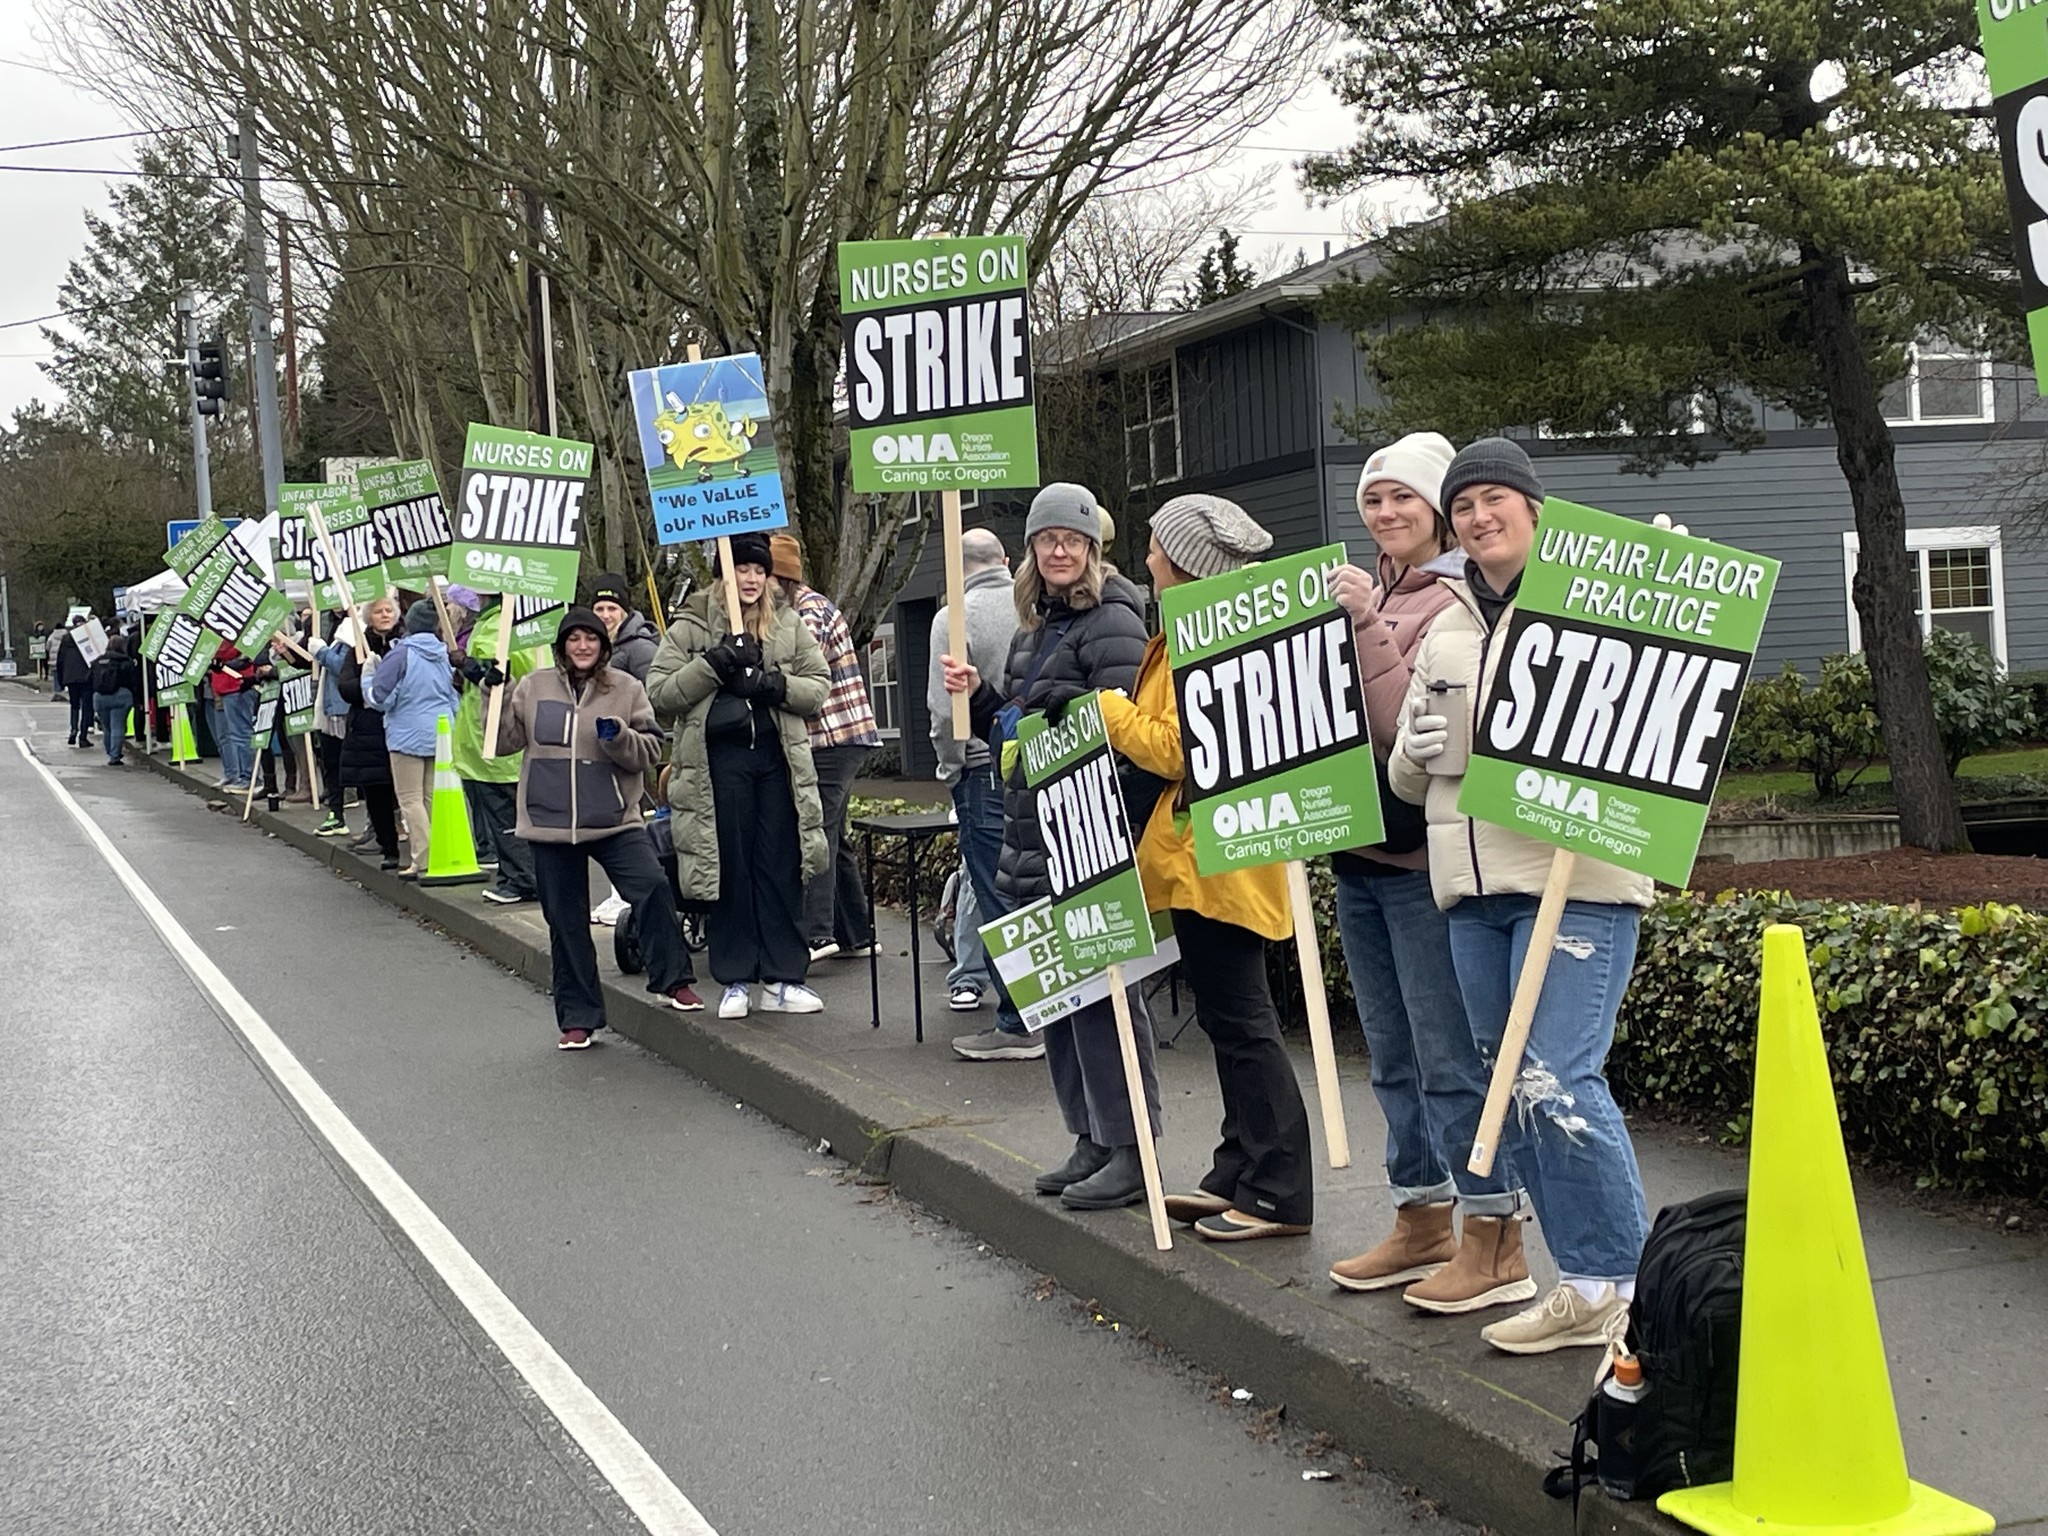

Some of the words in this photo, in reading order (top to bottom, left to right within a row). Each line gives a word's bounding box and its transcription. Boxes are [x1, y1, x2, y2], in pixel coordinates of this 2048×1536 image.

[852, 252, 968, 303] NURSES
[977, 245, 1018, 284] ON
[854, 297, 1025, 421] STRIKE
[471, 440, 553, 469] NURSES
[559, 447, 589, 472] ON
[872, 433, 959, 465] ONA
[961, 433, 993, 443] Oregon
[361, 471, 397, 492] UNFAIR
[397, 463, 430, 483] LABOR
[378, 482, 425, 503] PRACTICE
[881, 467, 928, 485] Caring
[932, 467, 951, 481] for
[954, 466, 1007, 483] Oregon
[282, 490, 314, 503] UNFAIR
[316, 485, 349, 500] LABOR
[460, 472, 585, 546] STRIKE
[170, 541, 197, 567] UNFAIR
[195, 517, 219, 542] LABOR
[373, 496, 451, 557] STRIKE
[663, 517, 696, 534] oUr
[184, 532, 221, 567] PRACTICE
[465, 549, 524, 577] ONA
[1539, 527, 1650, 579] UNFAIR
[1653, 548, 1765, 600] LABOR
[188, 571, 221, 616] NURSES
[214, 553, 232, 573] ON
[468, 571, 501, 588] Caring
[518, 579, 554, 594] Oregon
[204, 564, 268, 641] STRIKE
[1175, 577, 1290, 656] NURSES
[1563, 577, 1722, 636] PRACTICE
[146, 623, 167, 657] NURSES
[162, 609, 175, 624] ON
[158, 614, 201, 674] STRIKE
[1185, 617, 1359, 790] STRIKE
[1489, 621, 1742, 791] STRIKE
[1024, 716, 1079, 776] NURSES
[1078, 705, 1102, 742] ON
[1300, 785, 1332, 799] Oregon
[1301, 797, 1332, 810] Nurses
[1515, 768, 1600, 822] ONA
[1608, 796, 1641, 815] Oregon
[1036, 752, 1129, 897] STRIKE
[1212, 792, 1301, 838] ONA
[1303, 804, 1352, 822] Association
[1515, 803, 1562, 836] Caring
[1564, 818, 1584, 838] for
[1588, 827, 1643, 859] Oregon
[1602, 816, 1652, 841] Association
[1605, 806, 1636, 825] Nurses
[1224, 838, 1270, 861] Caring
[1274, 835, 1293, 850] for
[1297, 824, 1350, 847] Oregon
[1064, 904, 1109, 940] ONA
[1073, 945, 1098, 960] Caring
[1096, 941, 1106, 954] for
[1107, 936, 1137, 953] Oregon
[1040, 1001, 1068, 1019] ONA
